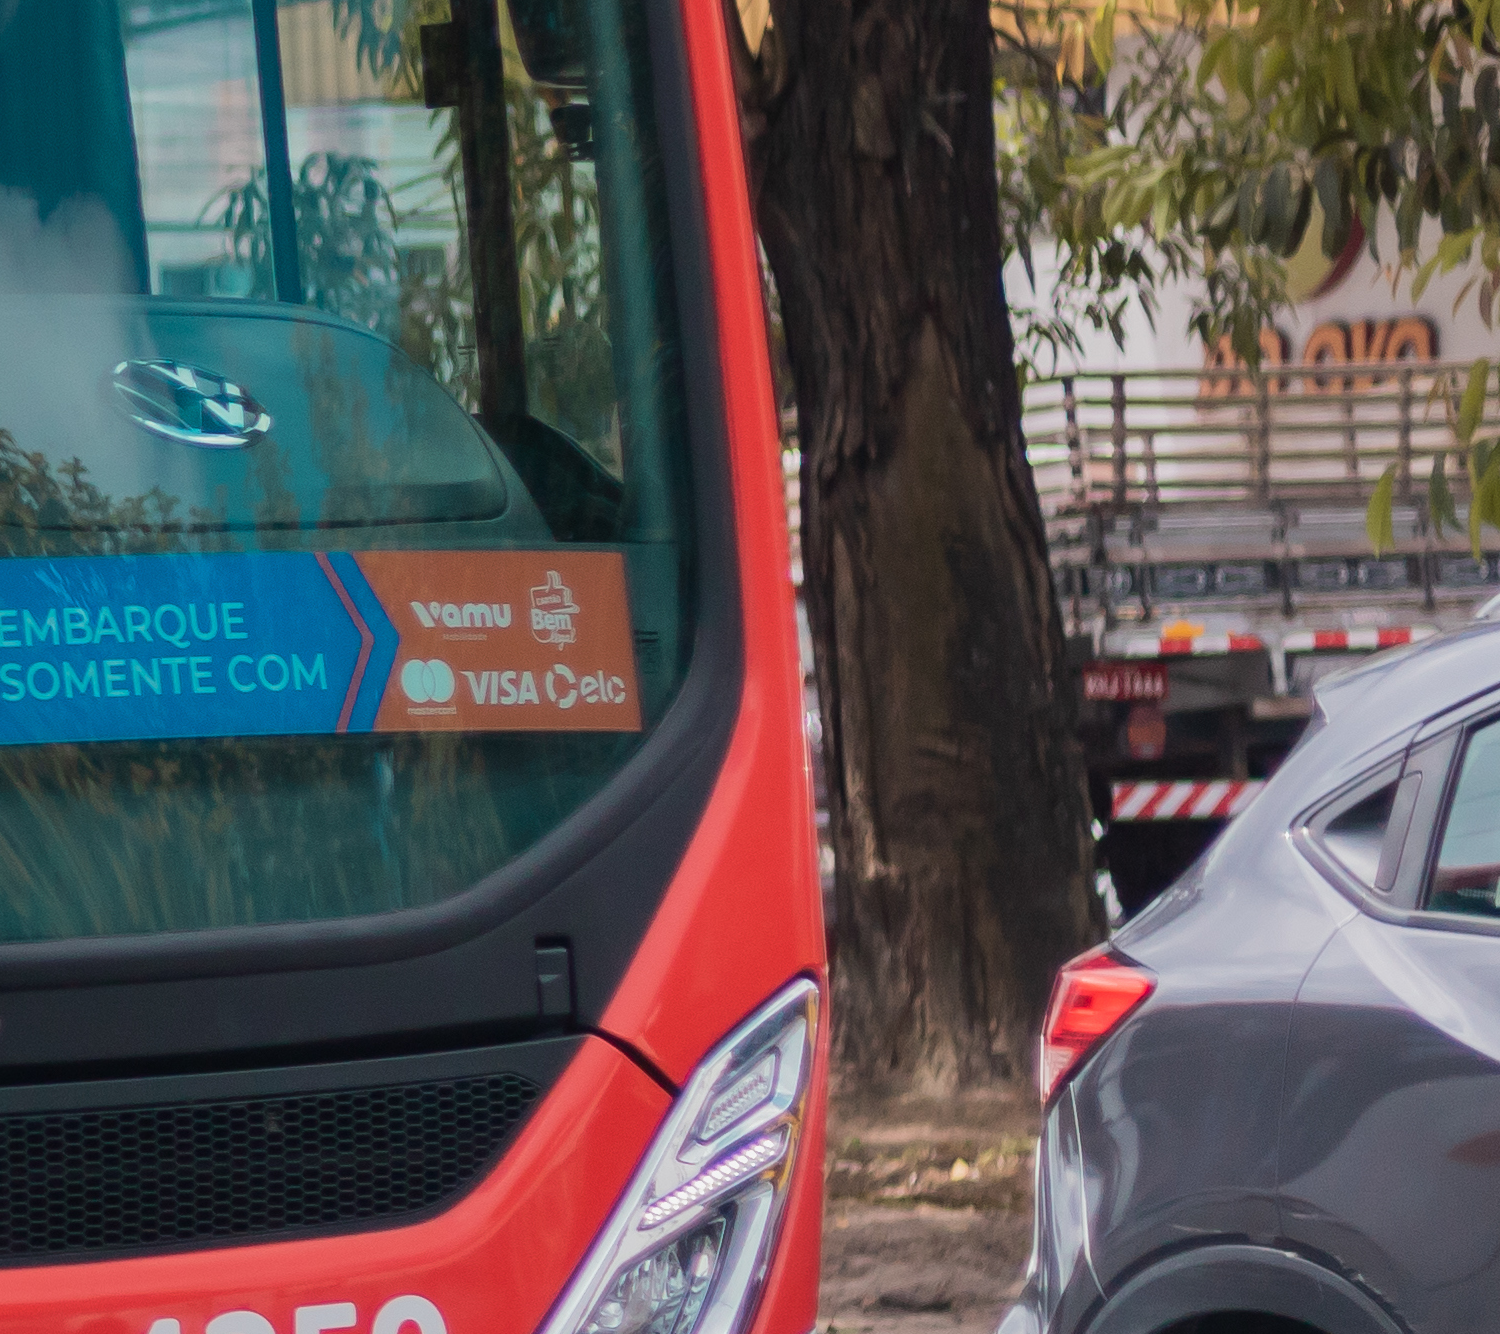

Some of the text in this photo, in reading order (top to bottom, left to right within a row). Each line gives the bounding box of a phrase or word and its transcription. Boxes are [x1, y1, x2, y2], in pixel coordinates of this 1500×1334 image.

[0, 652, 329, 703] SOMENTE COM
[459, 670, 540, 705] VISA
